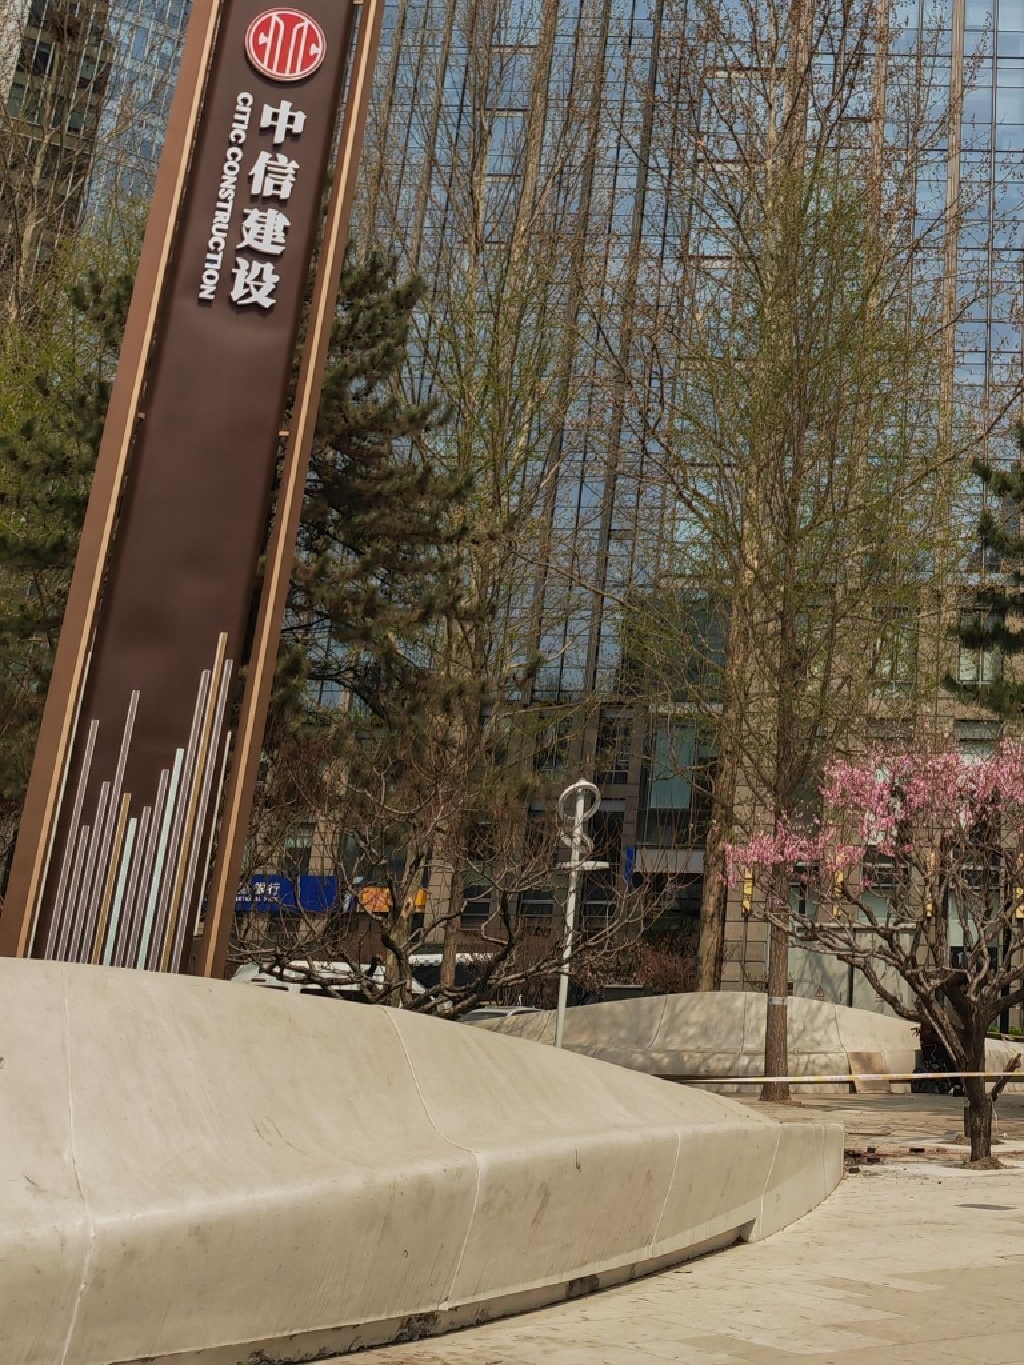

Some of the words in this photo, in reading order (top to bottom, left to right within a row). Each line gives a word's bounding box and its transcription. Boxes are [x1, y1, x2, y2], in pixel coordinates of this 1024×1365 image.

[228, 91, 254, 144] CITIC
[198, 146, 243, 301] CONSTRUCTION
[230, 99, 307, 309] 中信建设
